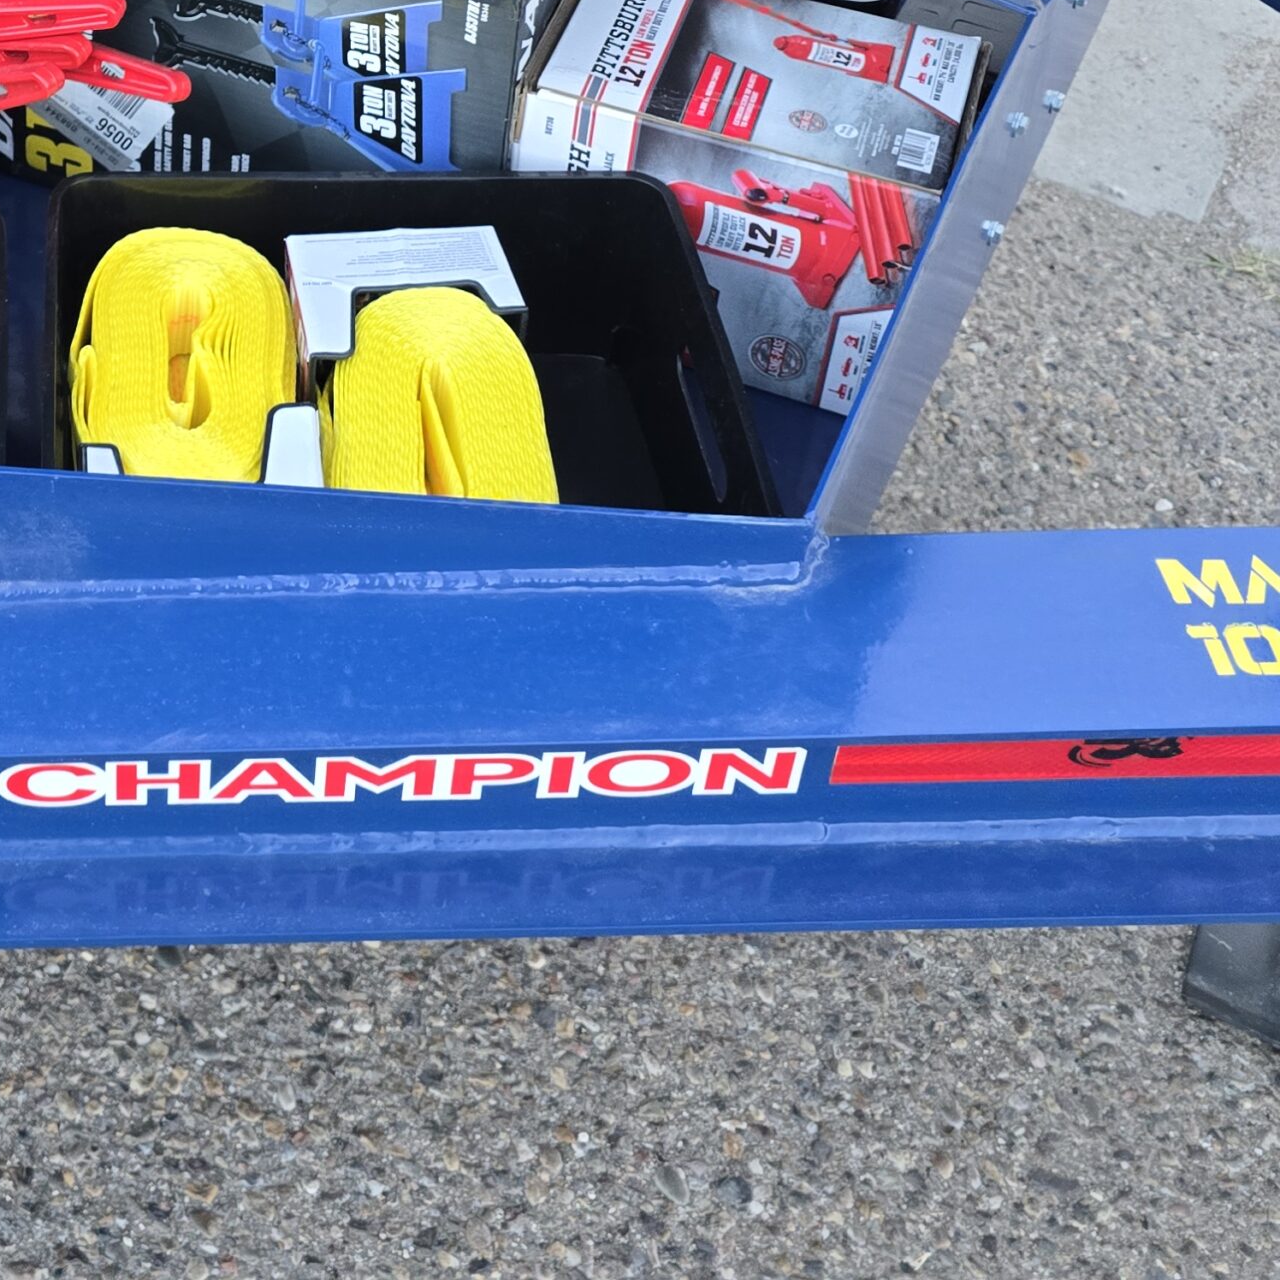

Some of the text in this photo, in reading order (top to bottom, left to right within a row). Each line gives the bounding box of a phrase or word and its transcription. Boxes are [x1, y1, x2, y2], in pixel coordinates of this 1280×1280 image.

[636, 9, 656, 38] LOW PROFILE
[645, 25, 658, 40] HEAVY
[652, 12, 663, 26] DUTY
[347, 22, 381, 72] 3 TON
[385, 13, 400, 76] AYTONA
[833, 51, 852, 67] 12
[614, 39, 656, 87] 12 TON
[360, 85, 397, 139] 3 TON
[401, 79, 416, 160] DAYTONA
[95, 118, 133, 151] 0056
[717, 211, 730, 236] PROFILE
[737, 215, 748, 232] JACK
[742, 222, 777, 258] 12
[776, 235, 795, 259] TON
